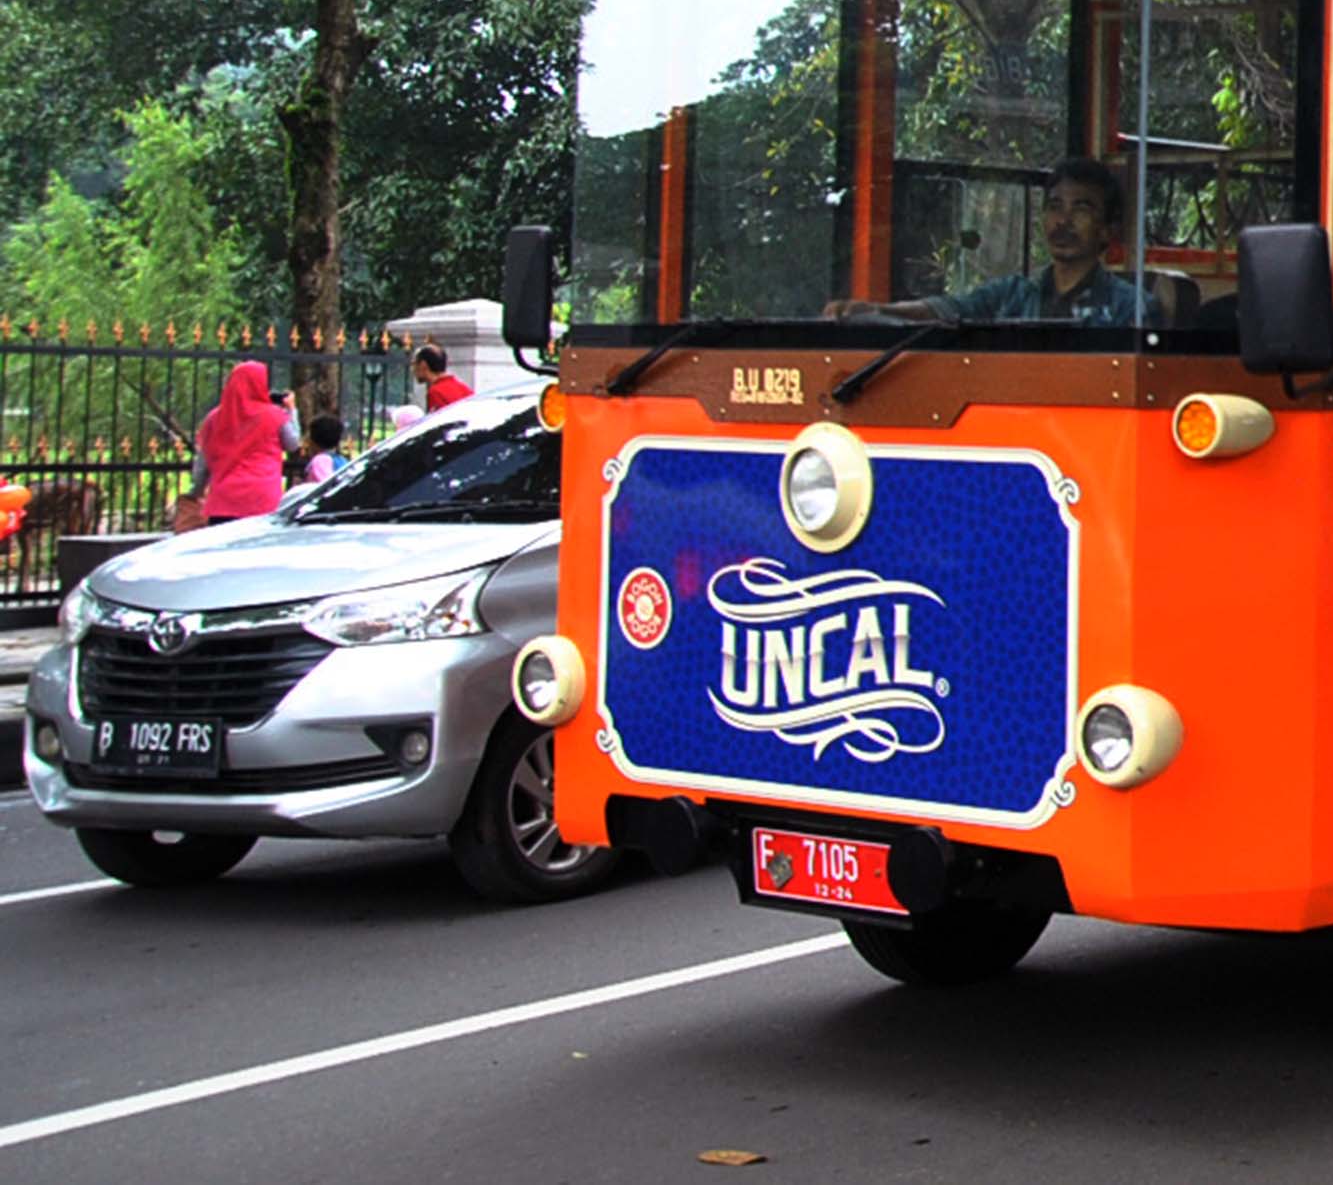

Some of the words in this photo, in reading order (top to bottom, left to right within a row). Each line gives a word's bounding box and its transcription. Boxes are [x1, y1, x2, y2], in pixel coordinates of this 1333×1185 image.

[763, 367, 801, 393] 0219
[720, 603, 935, 709] UNCAL
[99, 721, 115, 752] B
[130, 722, 173, 752] 1092
[177, 722, 213, 753] FRS
[759, 833, 775, 871] F
[802, 839, 860, 883] 7105
